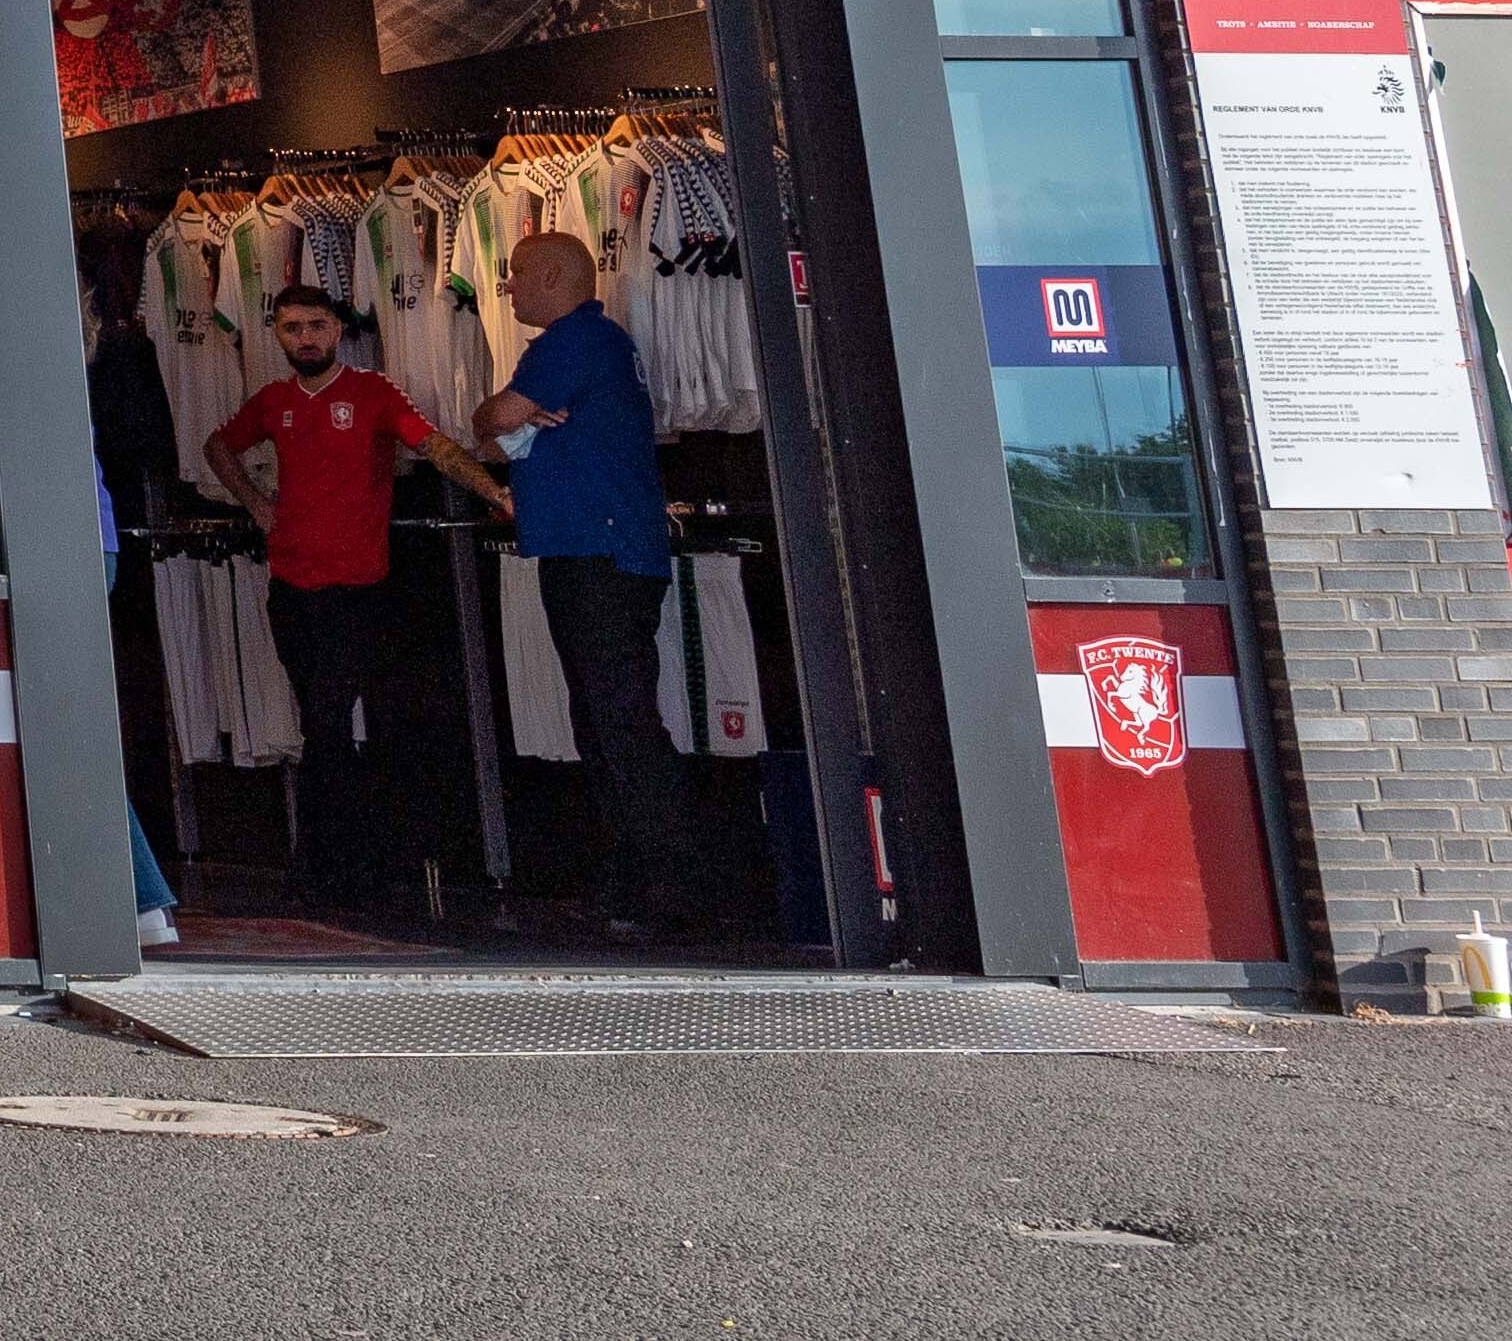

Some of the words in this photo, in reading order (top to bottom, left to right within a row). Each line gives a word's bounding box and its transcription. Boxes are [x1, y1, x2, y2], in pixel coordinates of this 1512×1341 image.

[1212, 105, 1260, 114] REGLEMENT
[1261, 105, 1278, 113] VAN
[1380, 105, 1406, 114] KNVB
[1051, 339, 1108, 353] MEYBA
[1111, 646, 1175, 664] TWENTE
[1129, 748, 1162, 759] 1965
